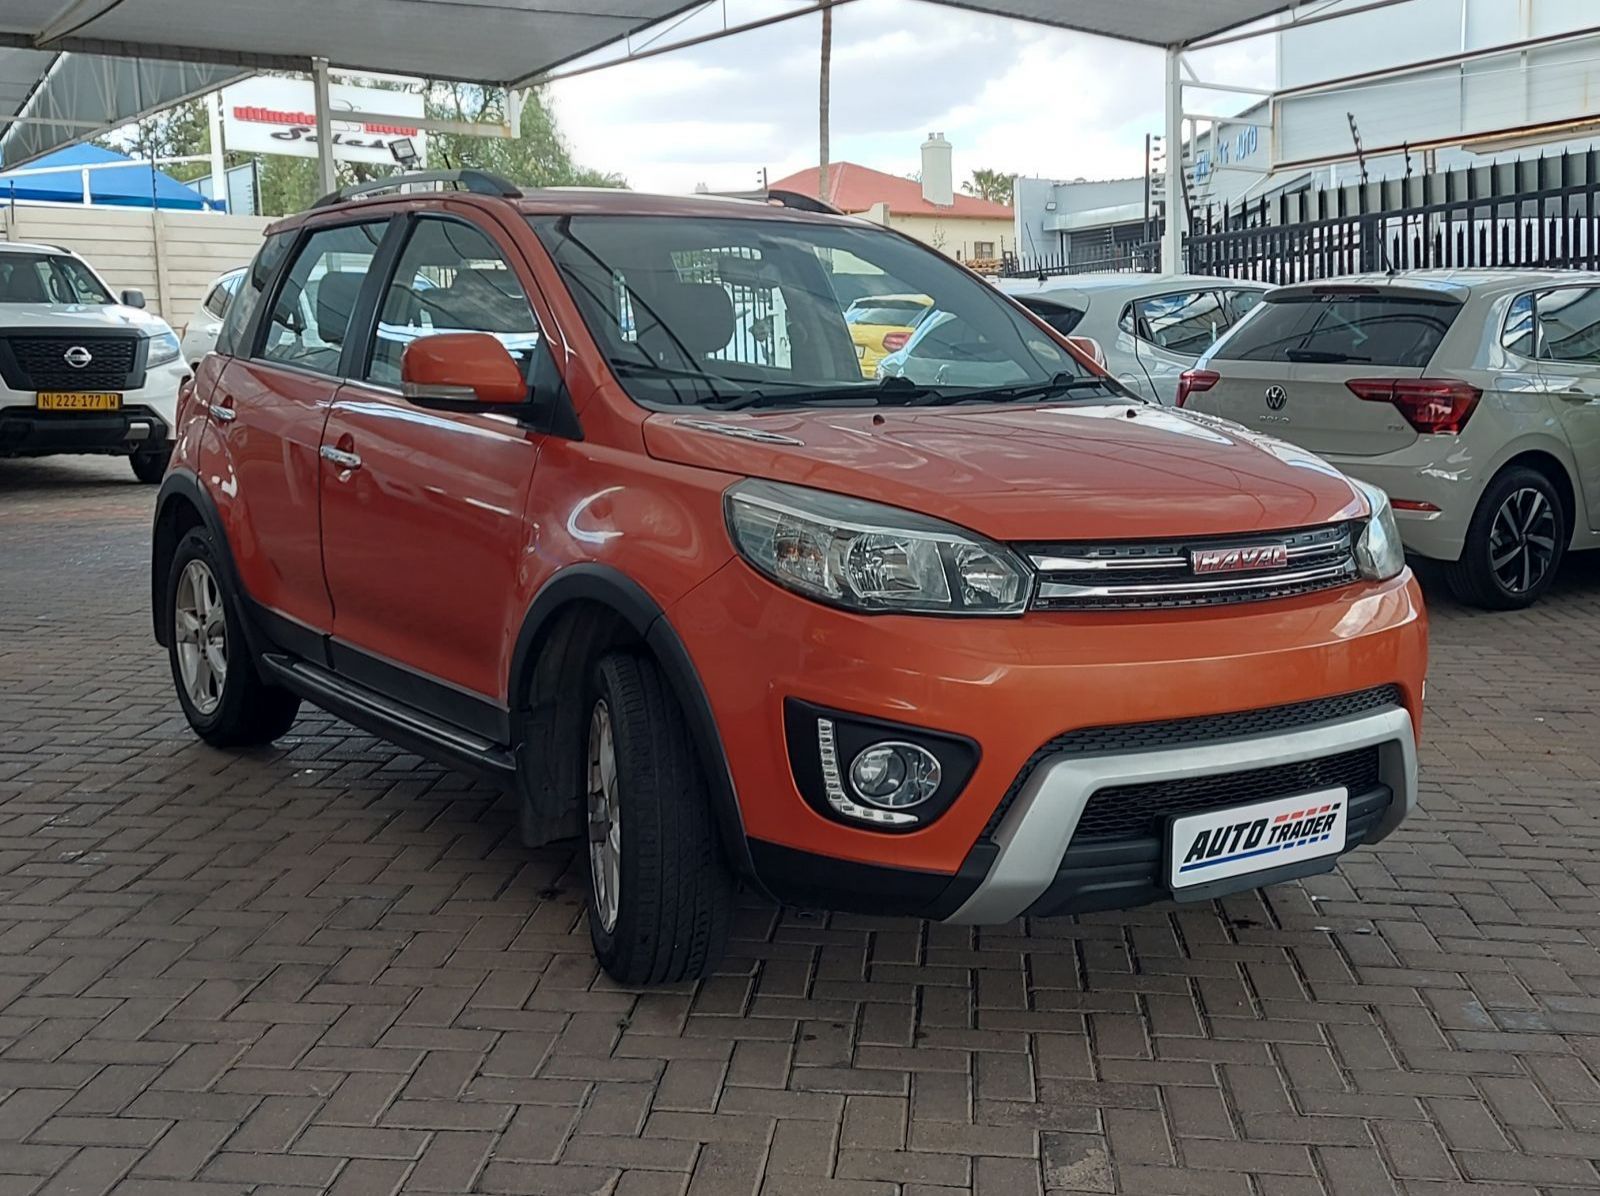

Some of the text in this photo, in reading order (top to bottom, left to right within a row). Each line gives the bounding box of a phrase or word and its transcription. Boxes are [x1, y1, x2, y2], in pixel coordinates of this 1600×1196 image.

[42, 394, 50, 407] N
[109, 395, 116, 407] W
[1198, 547, 1286, 571] HAVAL
[1183, 813, 1337, 864] AUTO TRADER
